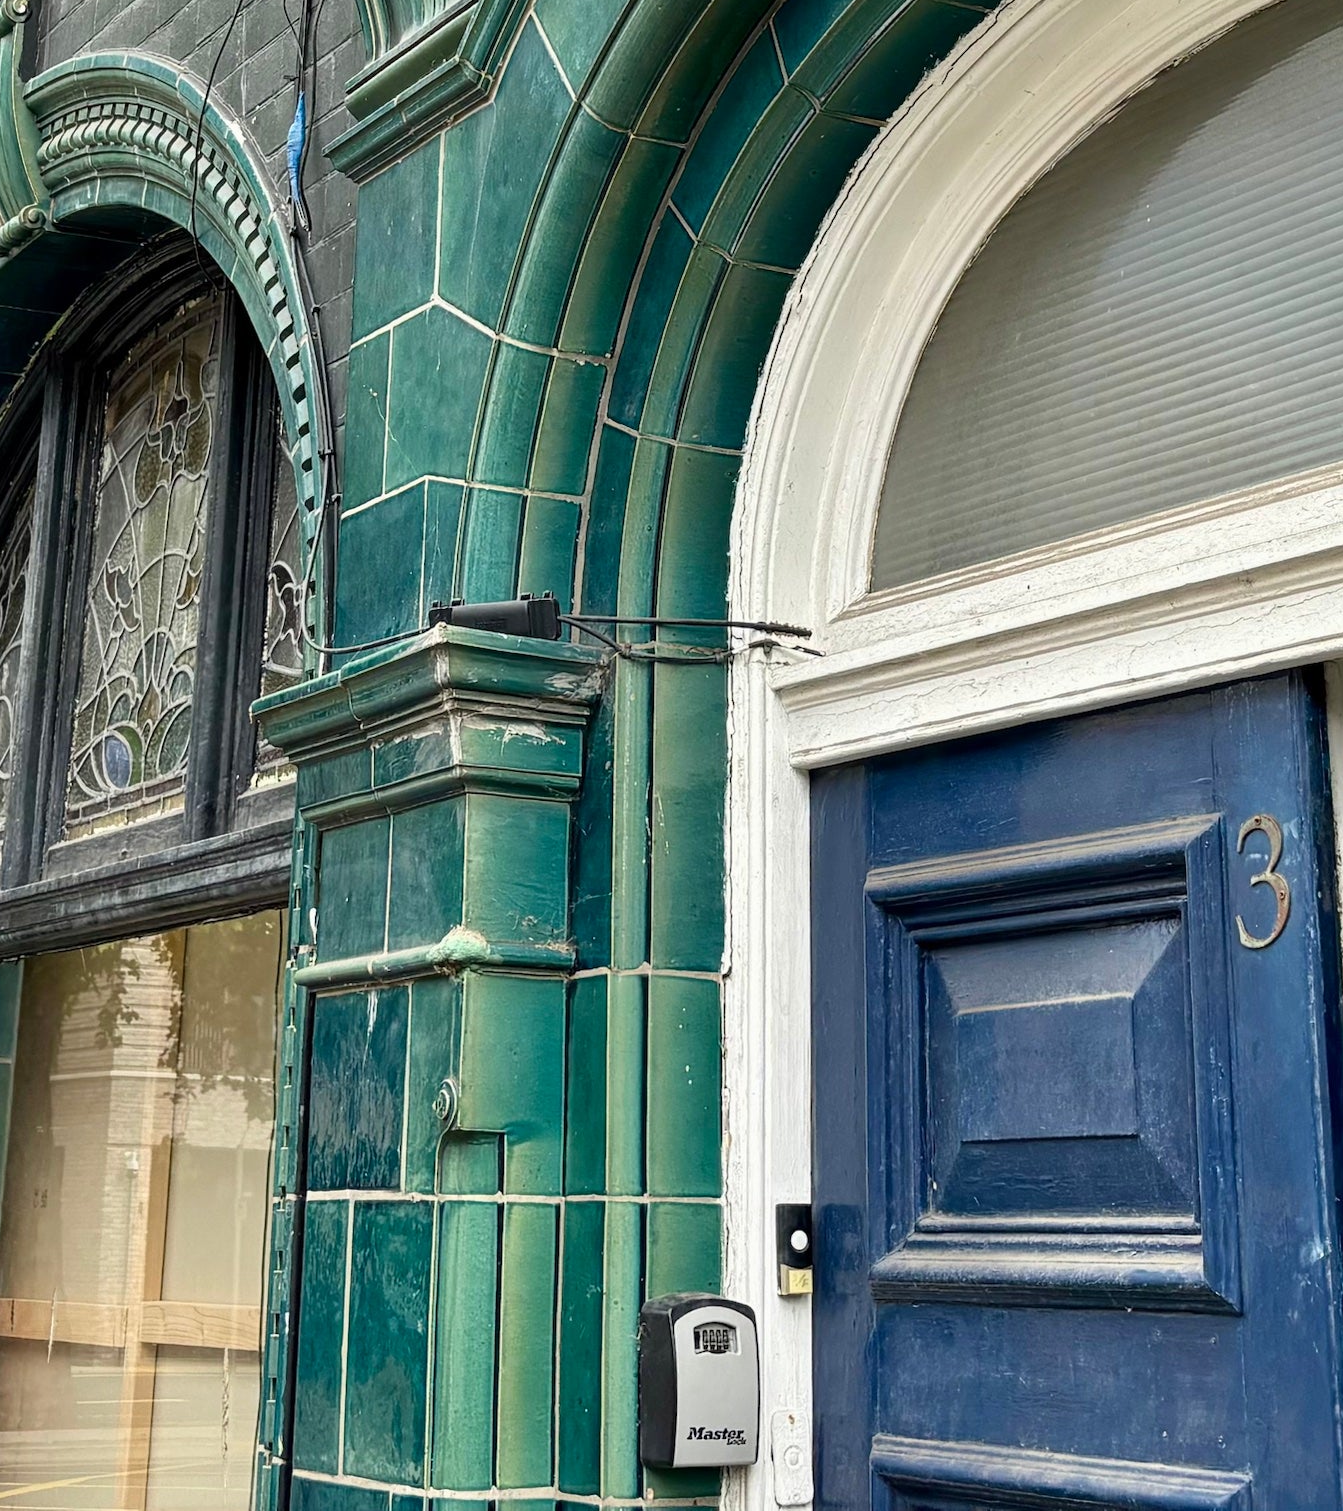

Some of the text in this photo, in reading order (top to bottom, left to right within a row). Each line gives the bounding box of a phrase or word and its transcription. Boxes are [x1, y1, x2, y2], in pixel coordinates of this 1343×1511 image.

[1235, 813, 1290, 949] 3
[687, 1427, 745, 1440] Master
[726, 1437, 747, 1446] Lock
